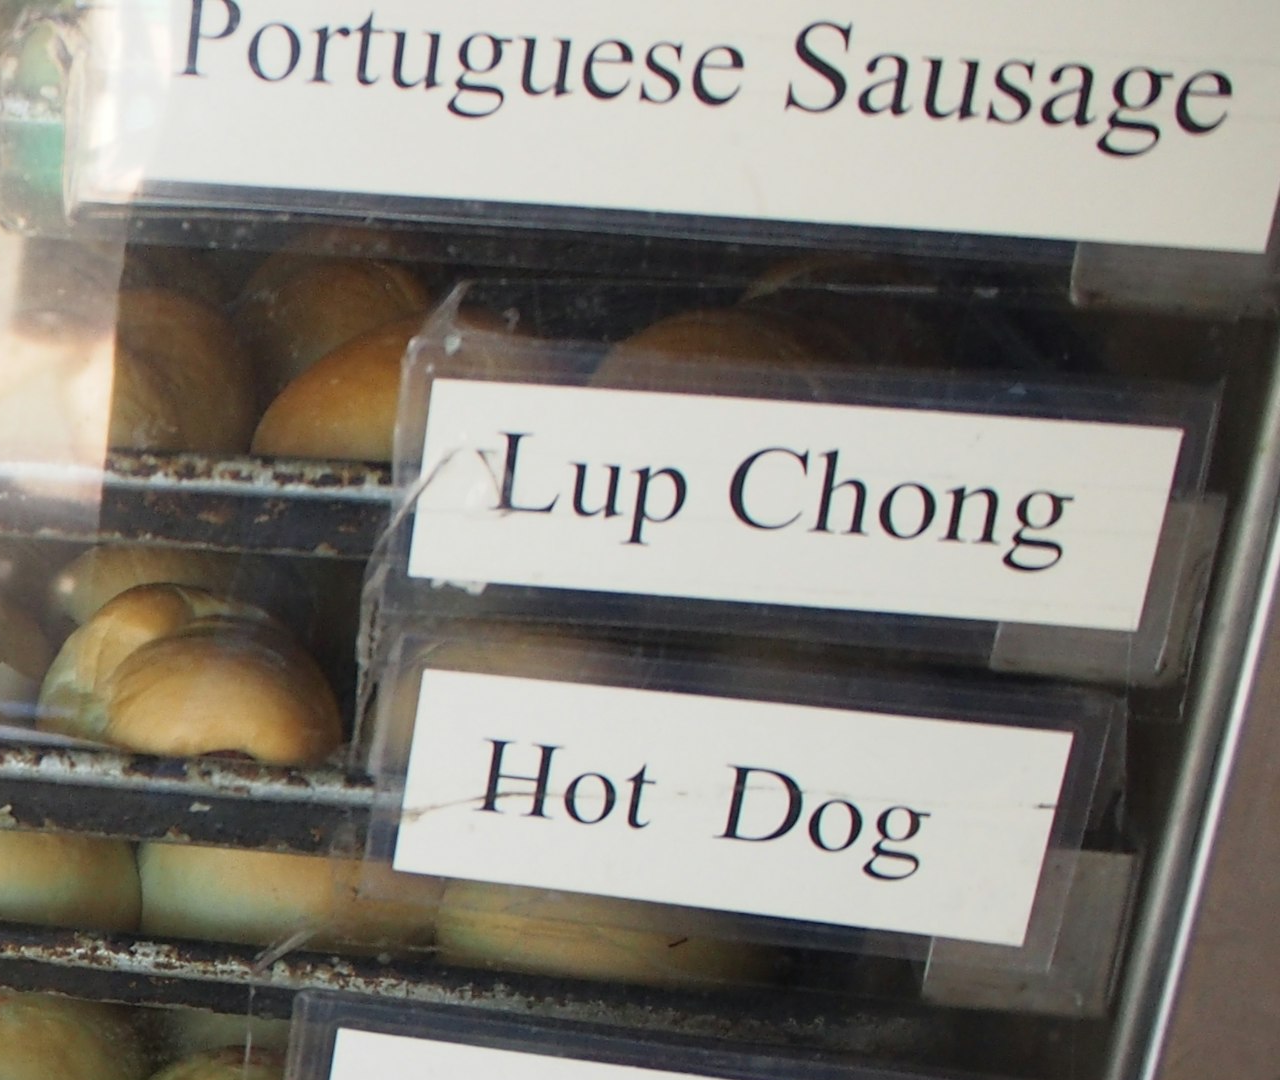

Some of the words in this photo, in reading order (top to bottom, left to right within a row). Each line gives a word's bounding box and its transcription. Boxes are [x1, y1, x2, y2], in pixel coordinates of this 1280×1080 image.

[179, 0, 745, 119] Portuguese
[785, 21, 1233, 158] Sausage
[495, 432, 687, 545] Lup
[729, 448, 1074, 573] Chong
[479, 739, 656, 829] Hot
[713, 765, 931, 881] Dog
